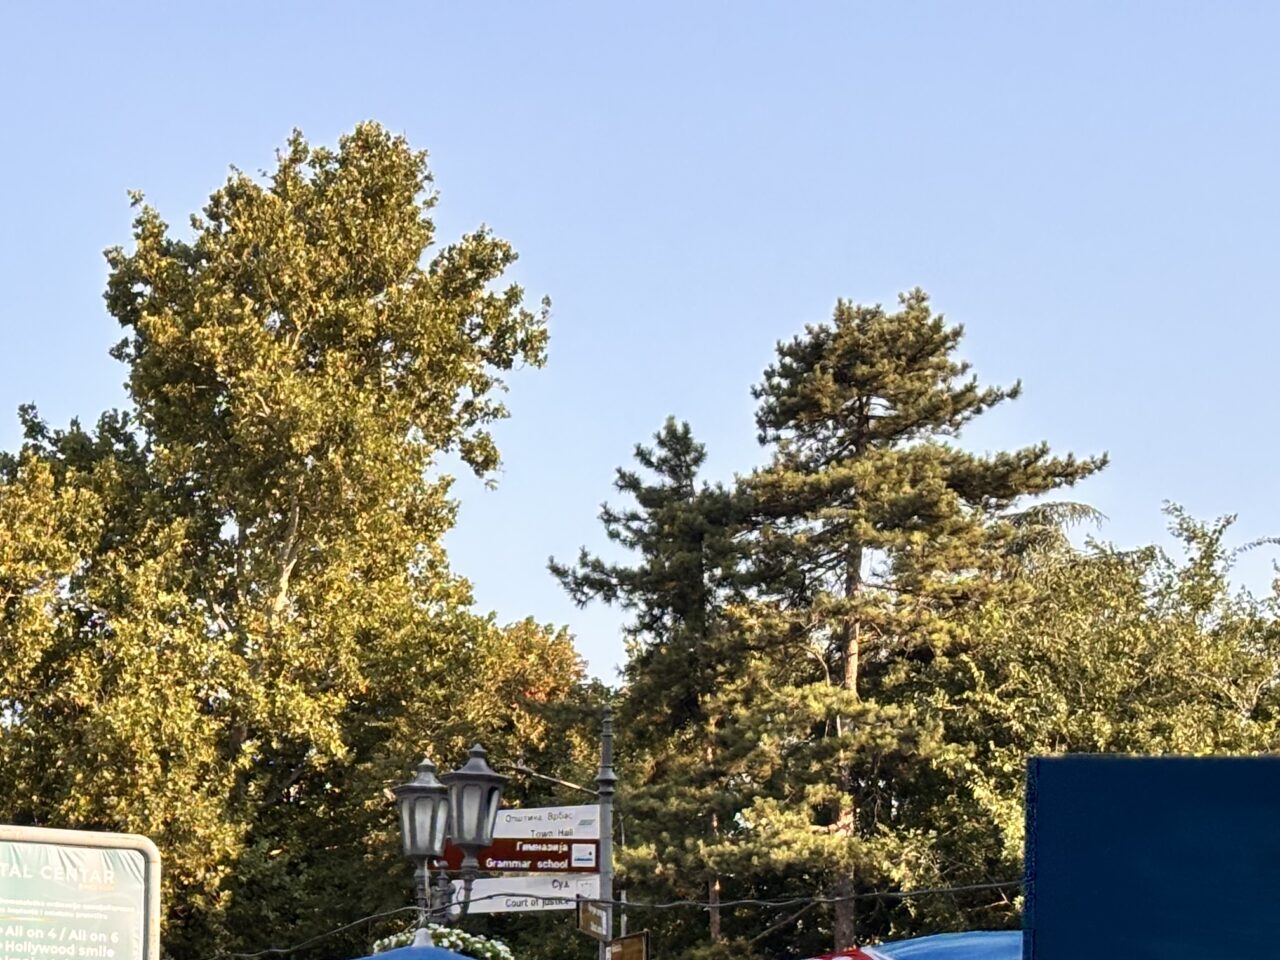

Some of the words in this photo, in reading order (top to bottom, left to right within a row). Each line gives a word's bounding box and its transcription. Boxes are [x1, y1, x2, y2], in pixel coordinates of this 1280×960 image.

[530, 829, 553, 837] Town
[558, 828, 574, 836] Hall
[516, 841, 569, 853] Гимназија
[486, 857, 532, 869] Grammar
[537, 859, 569, 868] school
[40, 865, 115, 885] CENTAR
[505, 898, 528, 908] Court
[531, 898, 539, 906] of
[5, 926, 23, 937] All
[26, 929, 43, 938] on
[47, 928, 56, 938] 4
[68, 929, 87, 941] All
[90, 932, 107, 942] on
[110, 932, 119, 943] 6
[4, 941, 75, 955] Hollywood
[78, 946, 115, 957] smile
